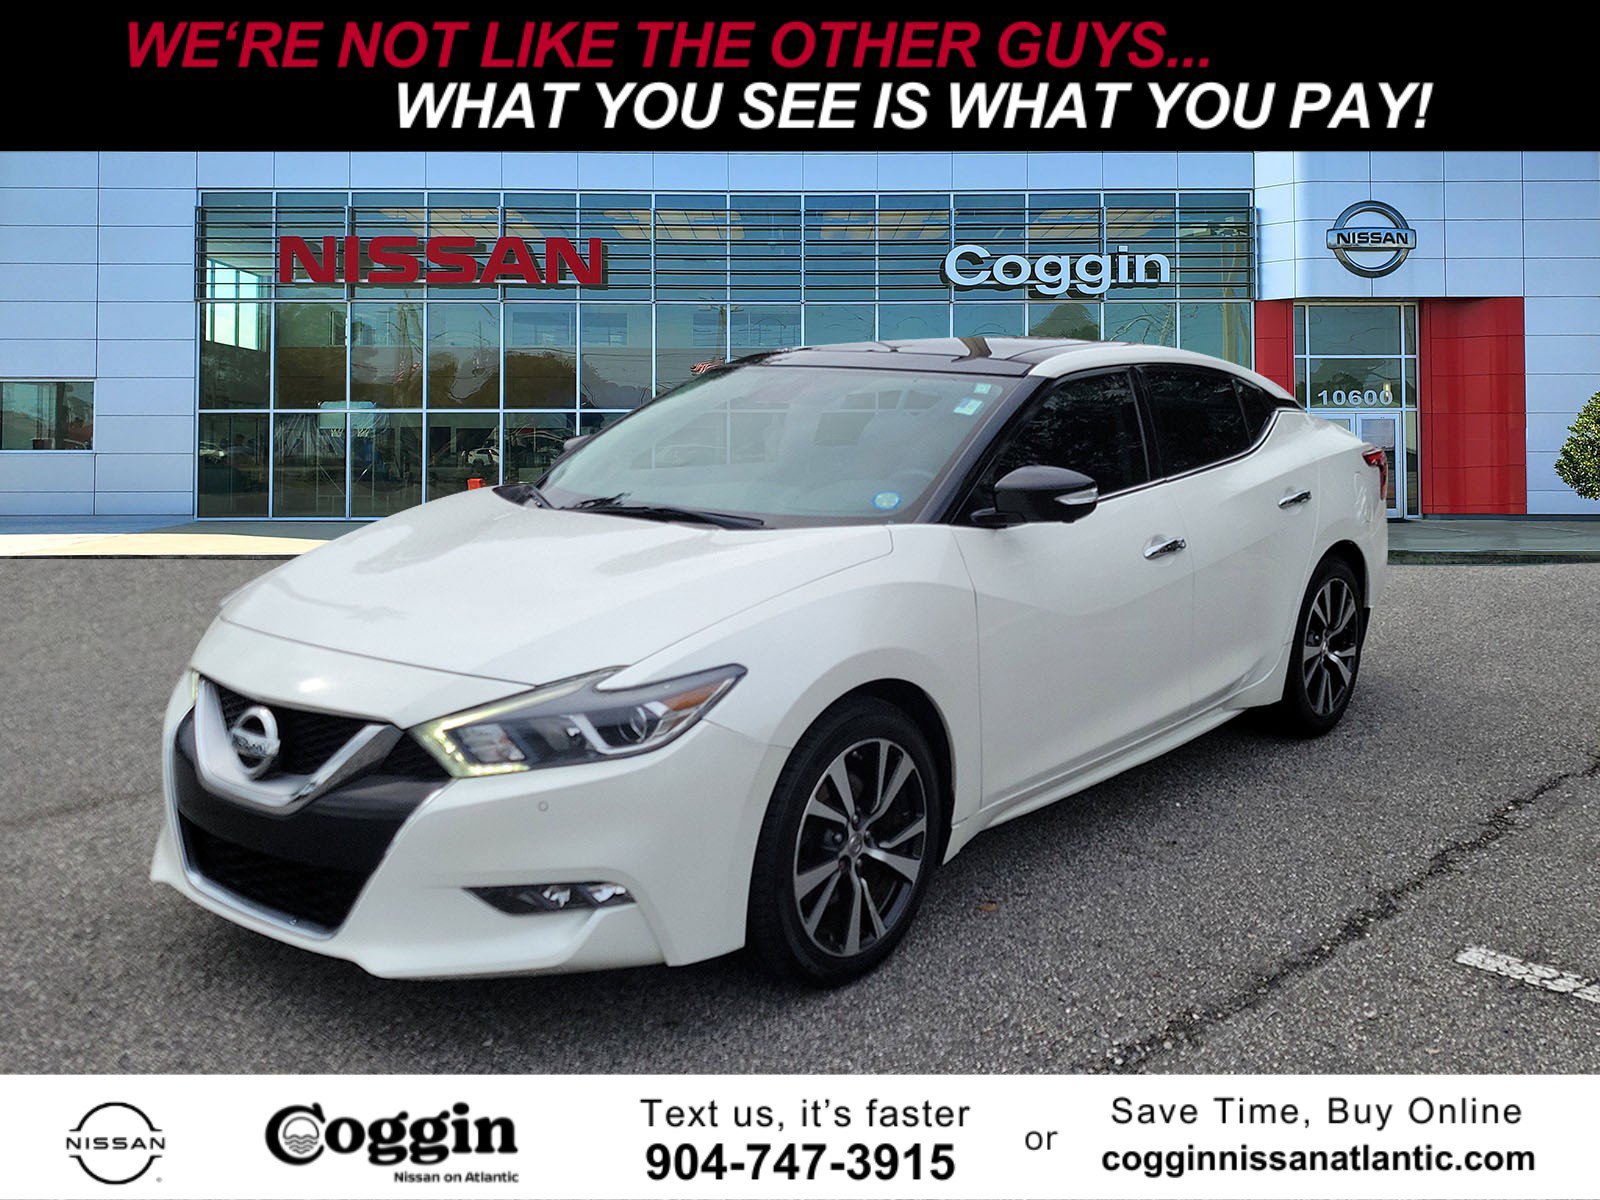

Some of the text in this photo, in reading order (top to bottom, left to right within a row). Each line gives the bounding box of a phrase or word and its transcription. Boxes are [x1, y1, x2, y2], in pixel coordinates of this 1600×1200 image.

[1336, 232, 1408, 245] NISSAN
[278, 235, 603, 285] NISSAN
[944, 245, 1171, 296] Coggin
[1317, 389, 1393, 406] 10600
